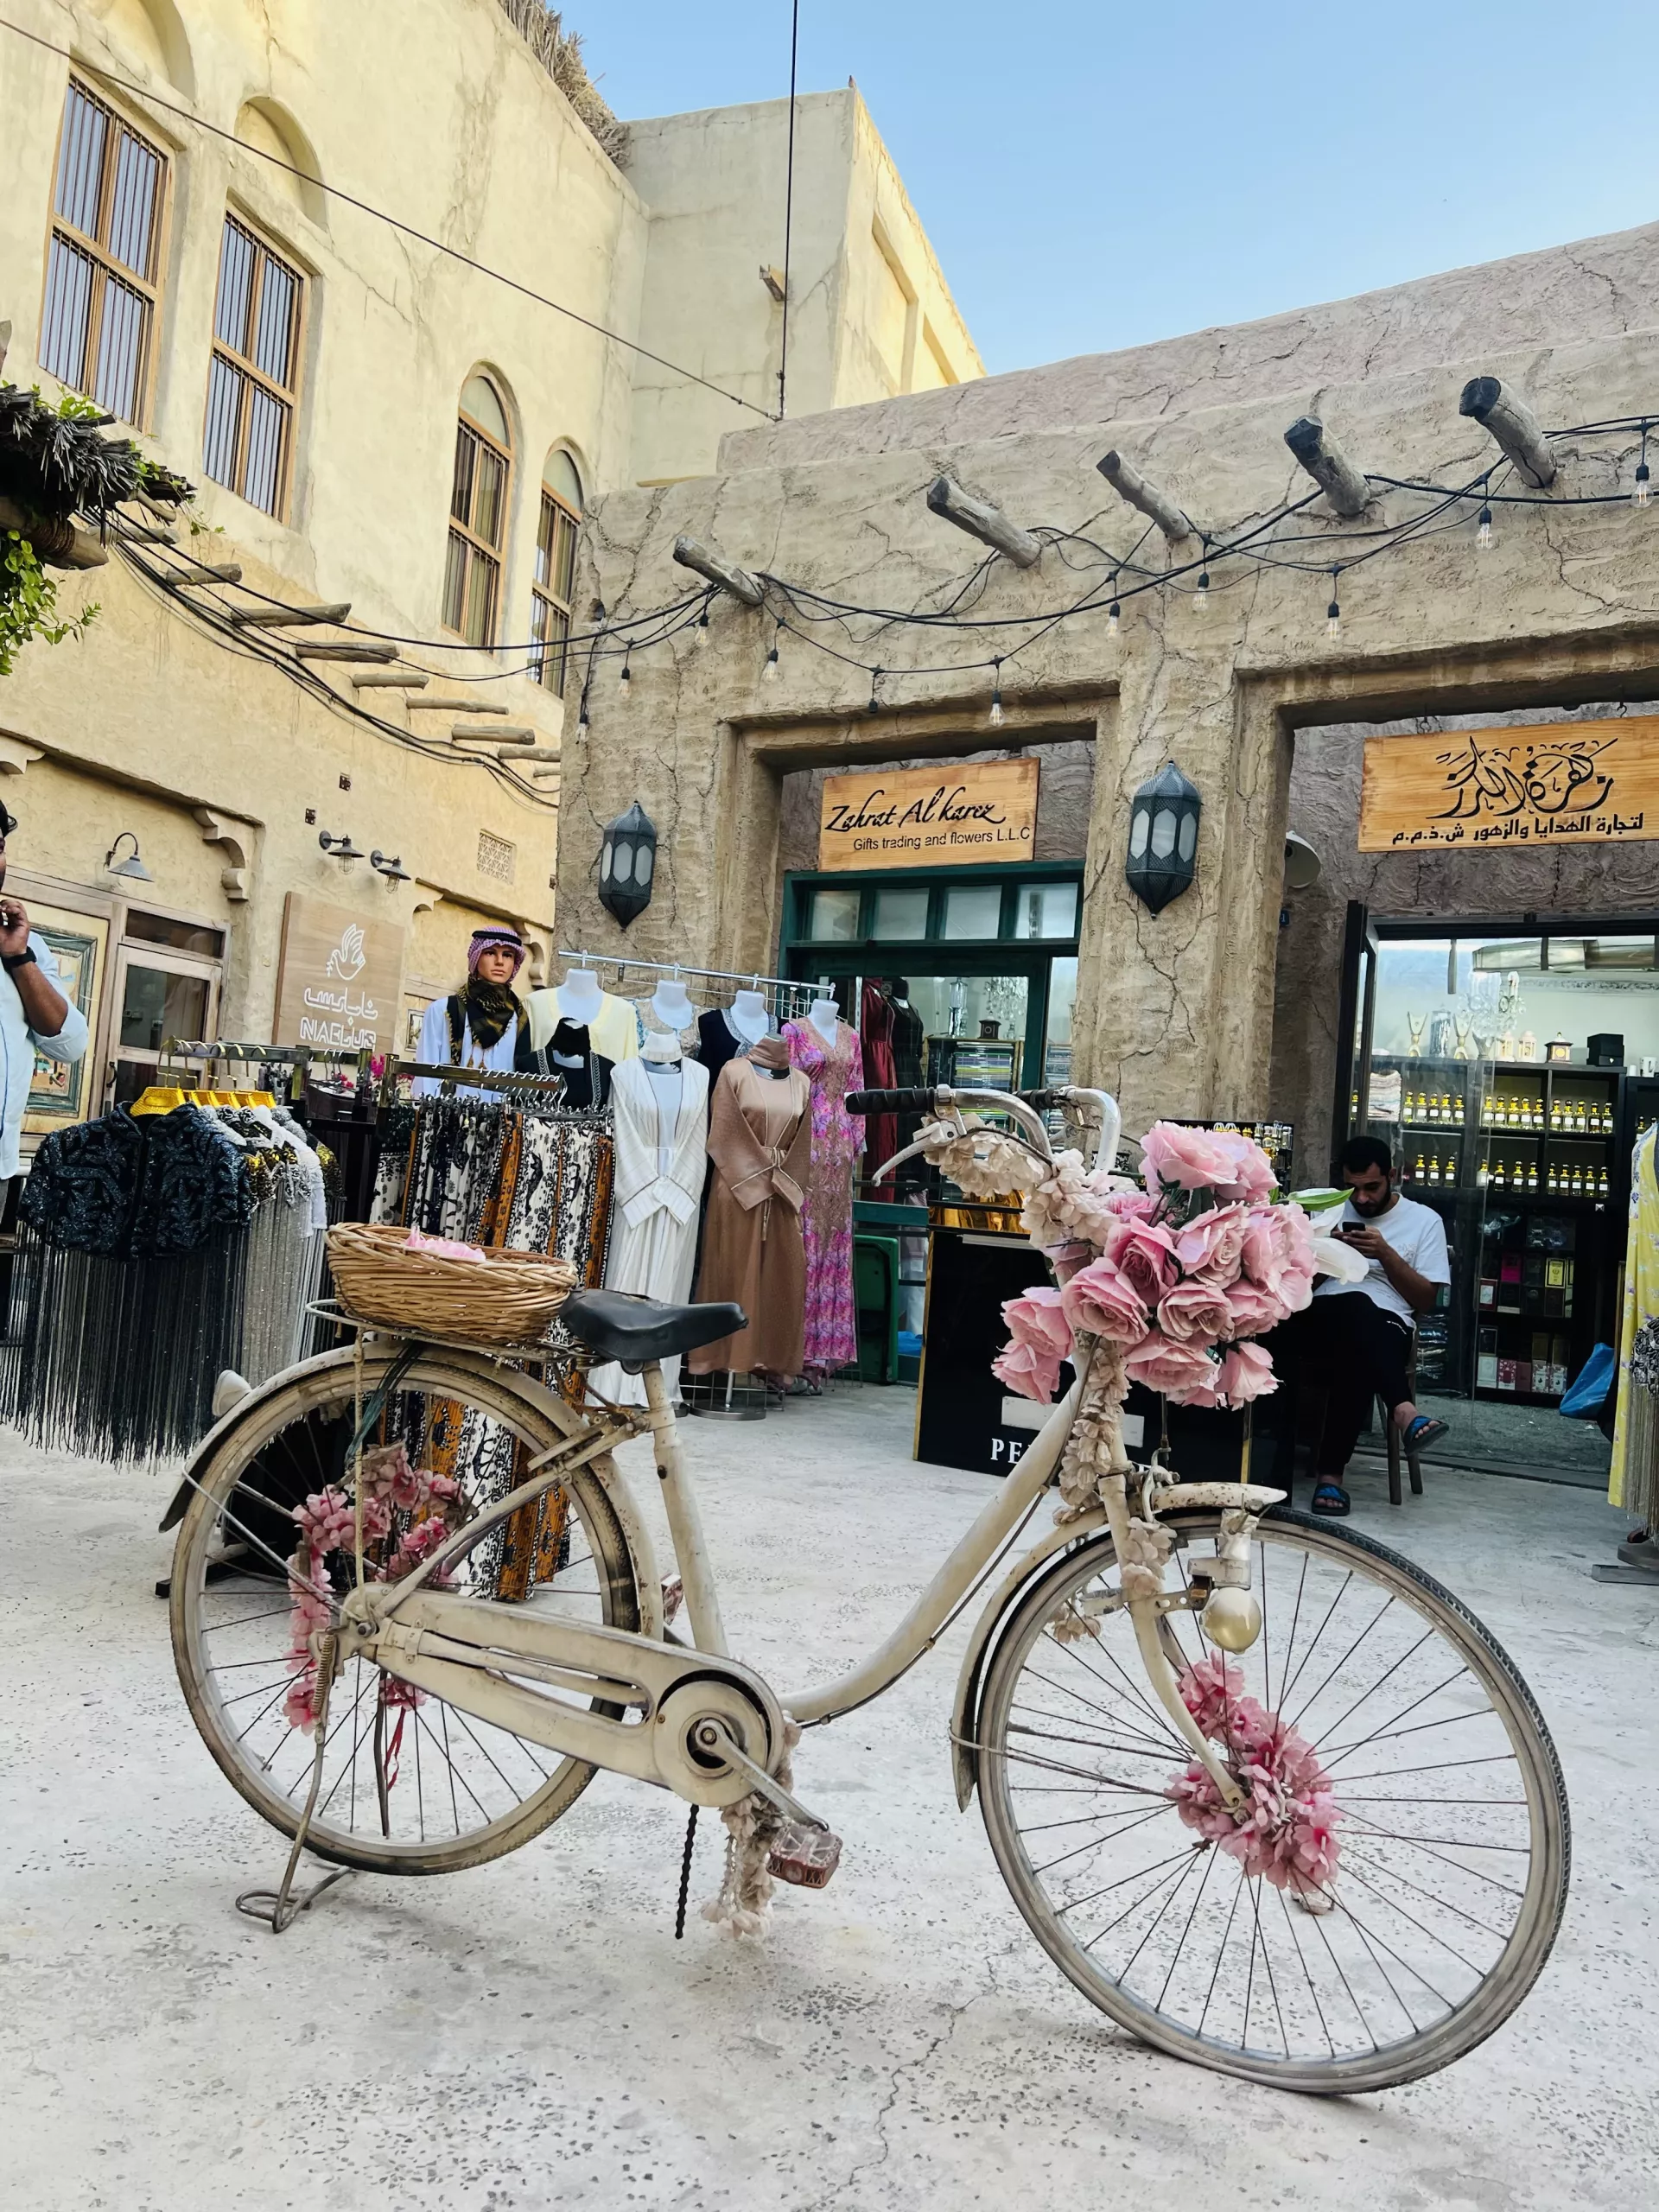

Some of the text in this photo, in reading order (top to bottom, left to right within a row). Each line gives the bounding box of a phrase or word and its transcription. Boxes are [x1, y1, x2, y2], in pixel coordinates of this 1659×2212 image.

[824, 789, 897, 832] Zahrat
[898, 786, 945, 828] Al
[1473, 819, 1528, 842] والزهور
[1535, 815, 1591, 839] الهدايا
[1597, 812, 1643, 836] لتجارة
[853, 826, 1031, 851] Gifts trading and flowers L.L.C
